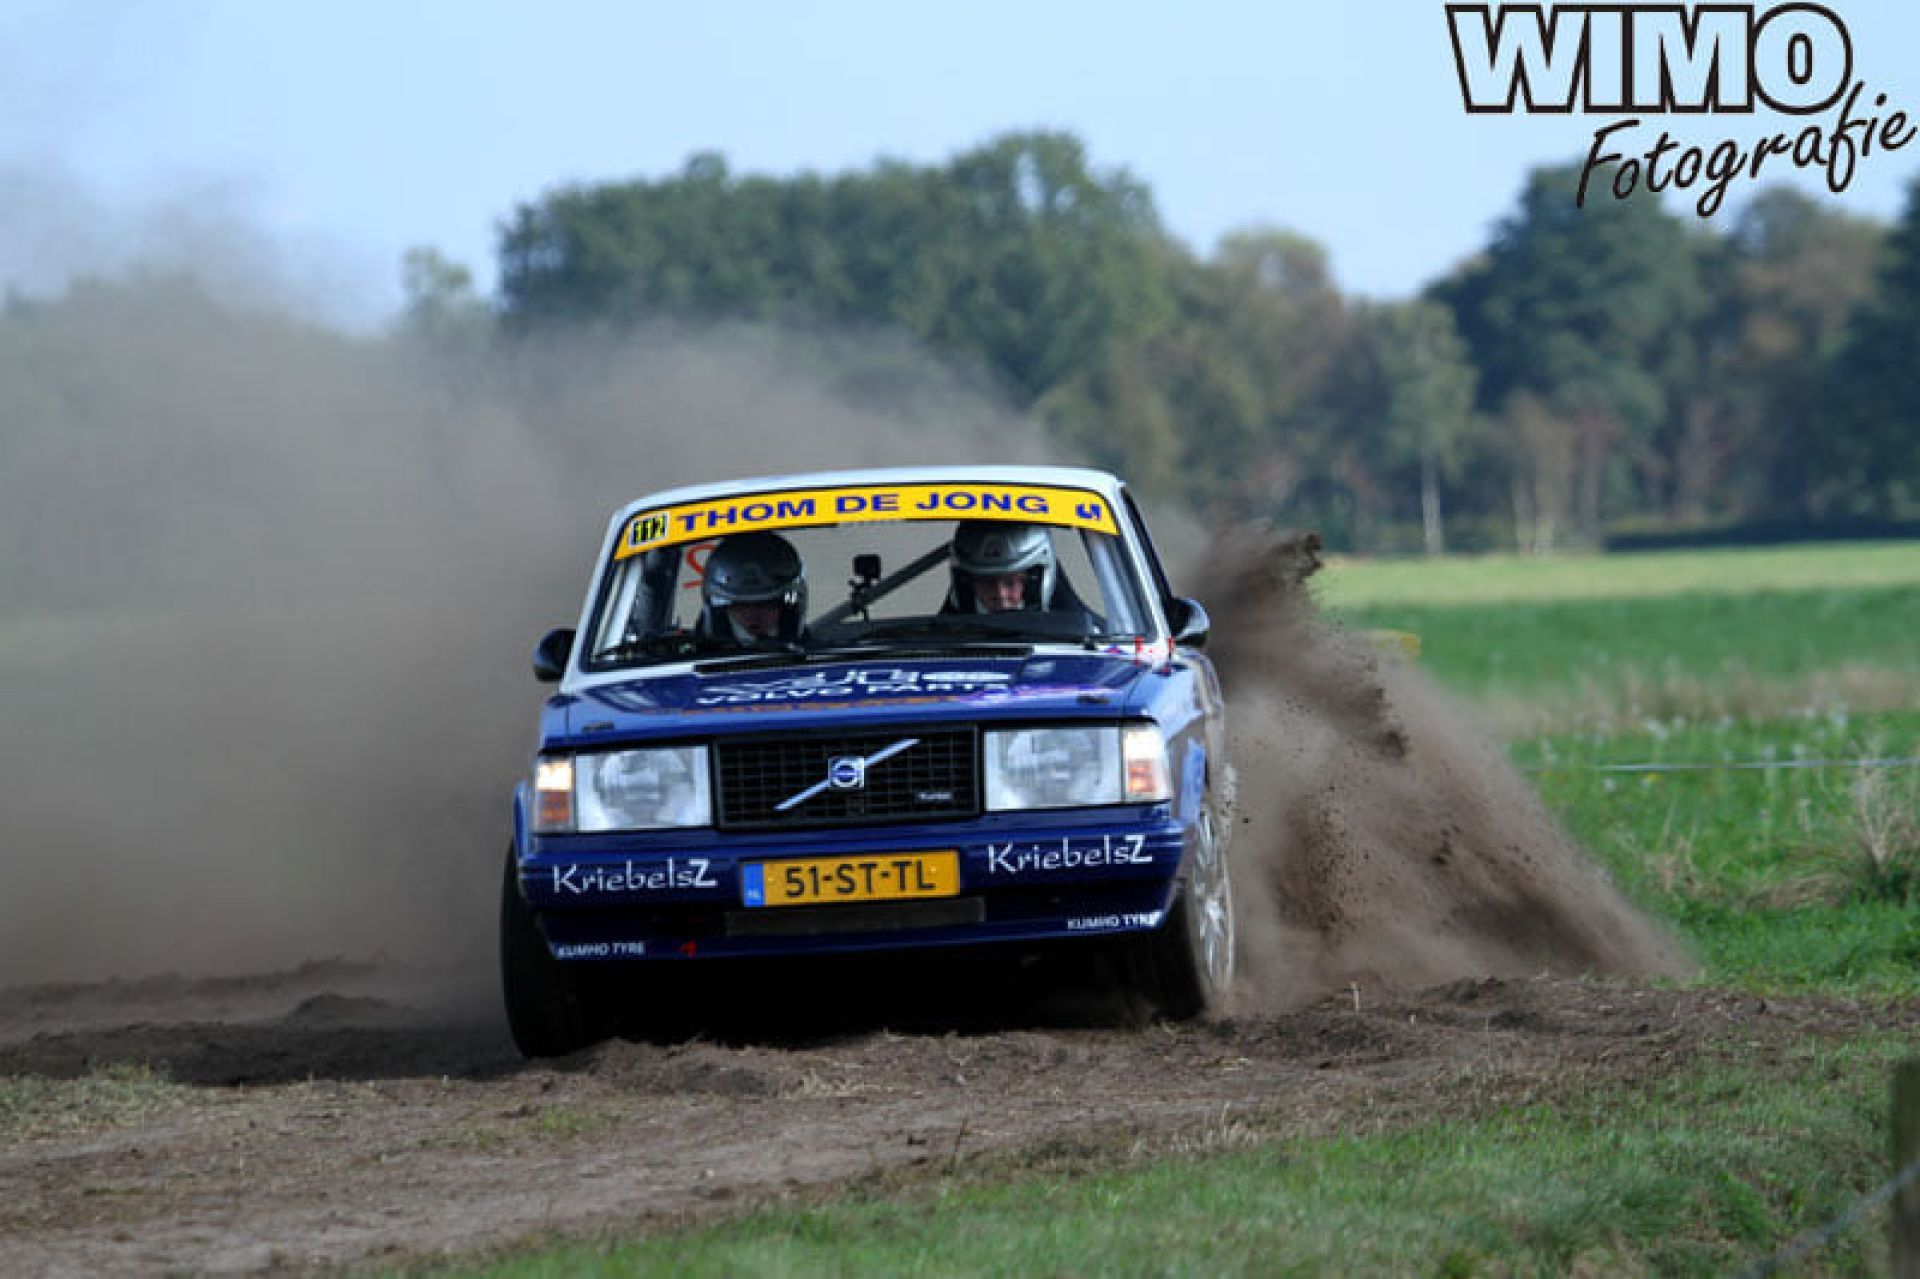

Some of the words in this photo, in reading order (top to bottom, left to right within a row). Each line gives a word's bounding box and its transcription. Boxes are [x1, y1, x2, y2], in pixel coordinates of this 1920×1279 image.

[676, 498, 816, 531] THOM
[836, 494, 900, 514] DE
[914, 491, 1050, 514] JONG
[987, 834, 1153, 875] KriebelsZ
[553, 856, 718, 894] KriebelsZ
[784, 859, 937, 898] 51-ST-TL
